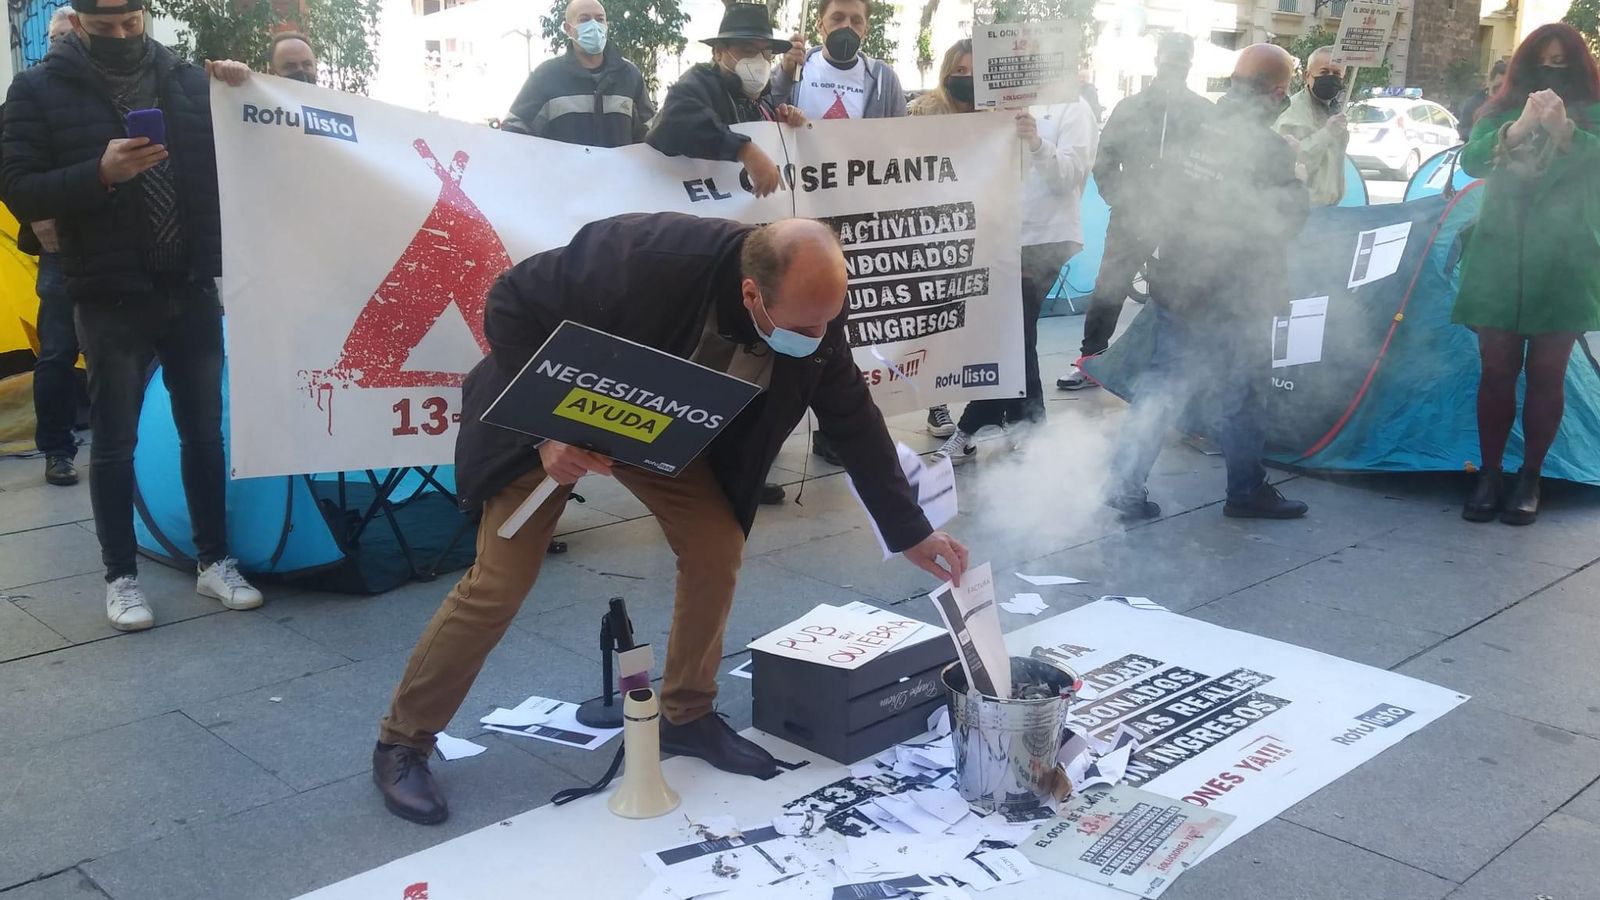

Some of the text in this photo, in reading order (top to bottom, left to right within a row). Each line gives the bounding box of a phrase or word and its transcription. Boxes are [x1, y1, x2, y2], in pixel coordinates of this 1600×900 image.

[1000, 29, 1018, 37] OCIO
[682, 177, 732, 203] EL
[801, 161, 838, 193] SE
[847, 155, 959, 187] PLANTA
[839, 210, 970, 245] ACTIVIDAD
[918, 273, 984, 302] REALES
[858, 308, 959, 343] INGRESOS
[535, 358, 725, 431] NECESITAMOS
[566, 396, 657, 435] AYUDA
[776, 625, 837, 653] PUB
[828, 620, 918, 664] QUIEBRA
[1166, 671, 1263, 717] REALES
[1145, 699, 1279, 765] INGRESOS
[1035, 839, 1053, 848] EL
[1046, 821, 1071, 840] OCIO
[1066, 811, 1082, 823] SE
[1082, 850, 1094, 861] 13
[1092, 835, 1113, 853] MESES
[1095, 856, 1108, 866] 13
[1104, 840, 1126, 858] MESES
[1109, 850, 1133, 869] MESES
[1128, 840, 1142, 851] SIN
[1130, 846, 1153, 864] MESES
[1148, 837, 1162, 848] SIN
[1157, 841, 1189, 871] SOLUCIONES
